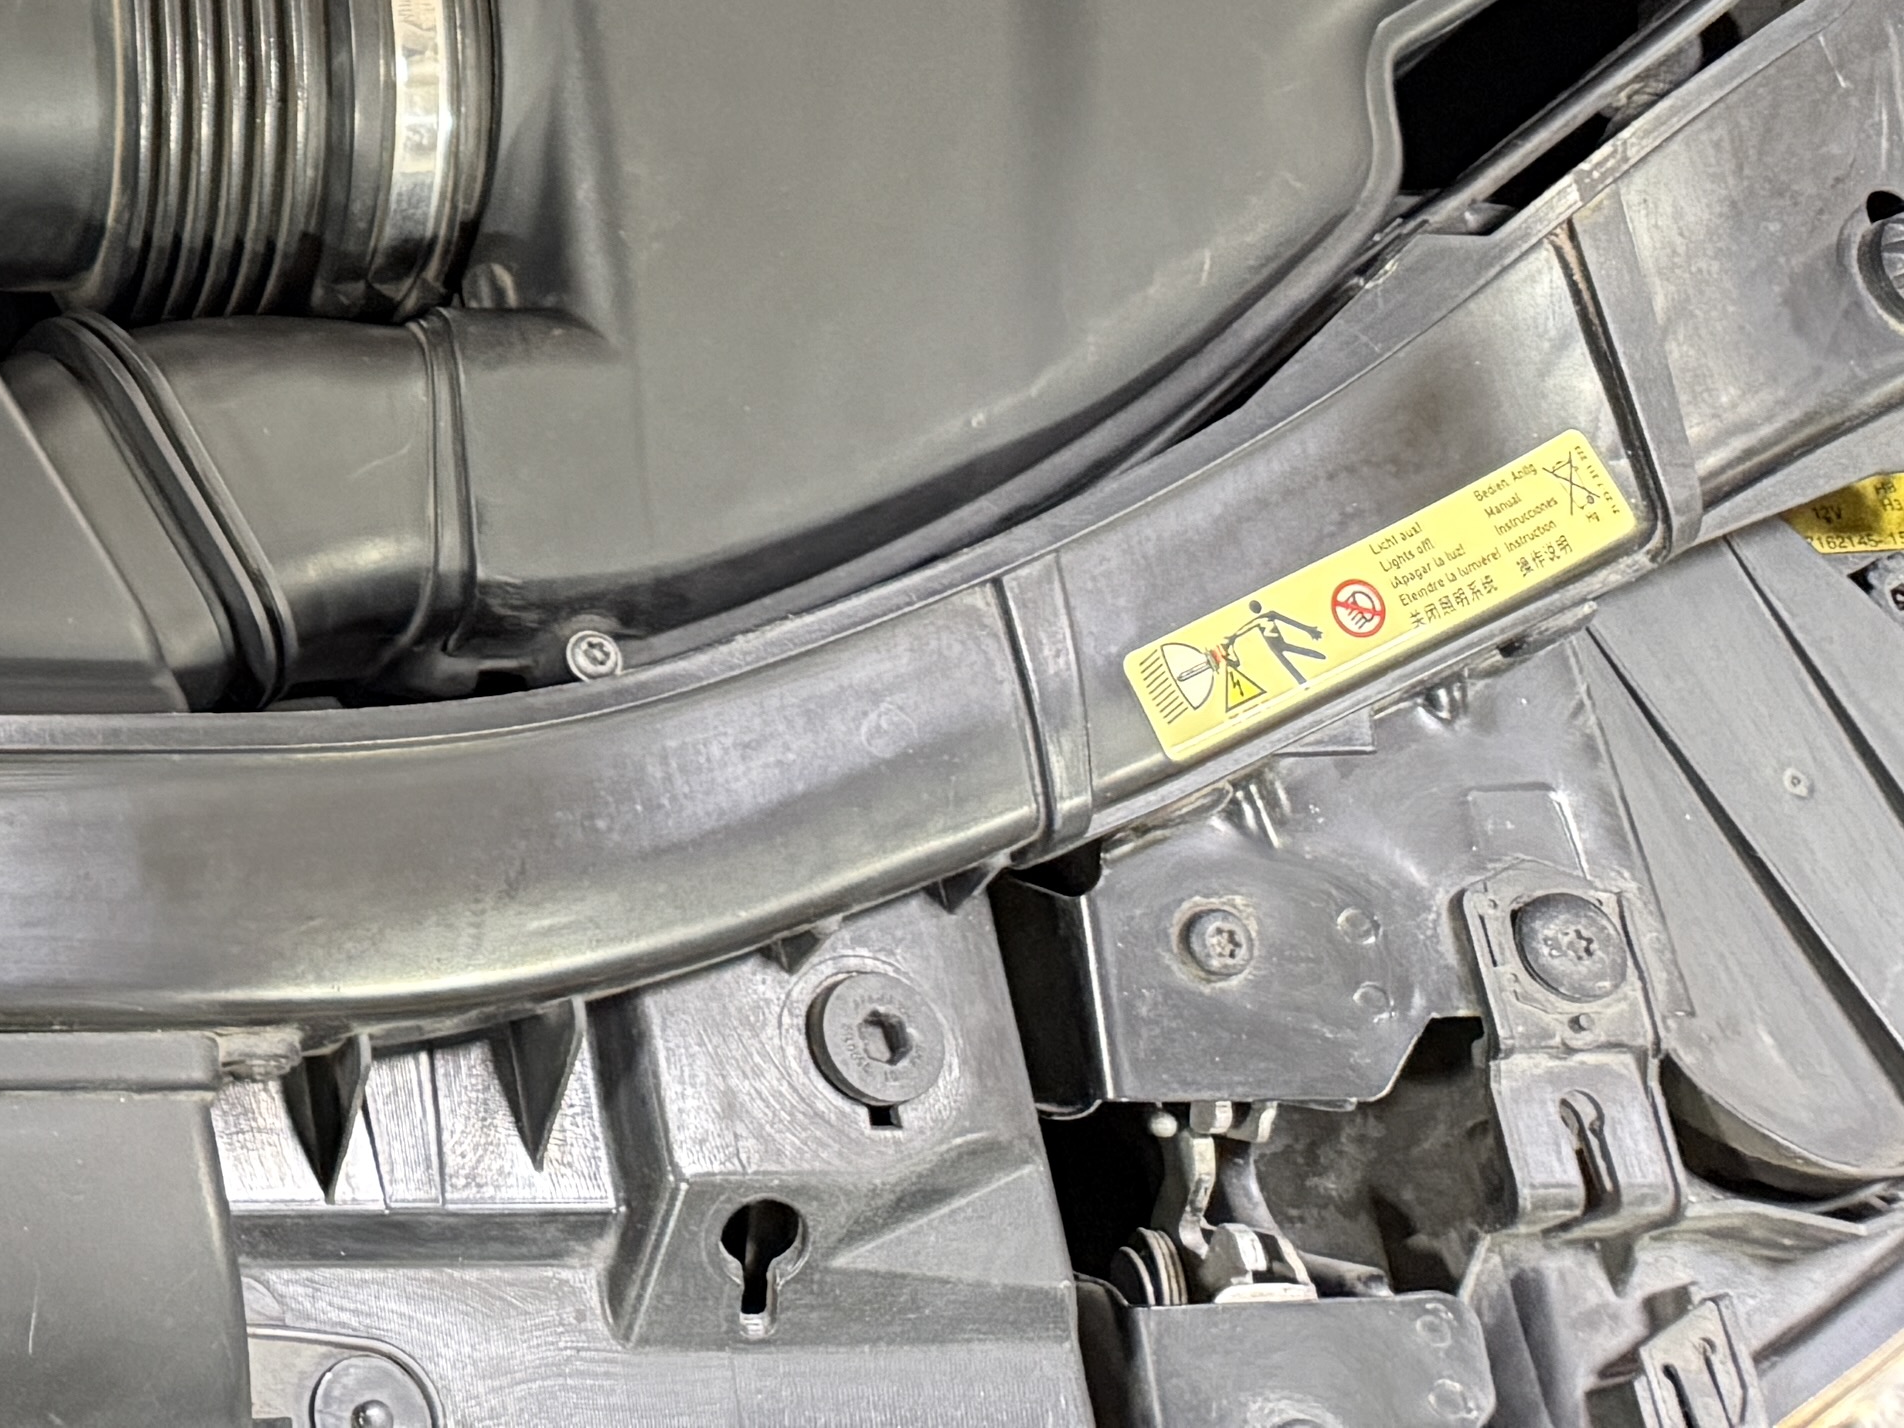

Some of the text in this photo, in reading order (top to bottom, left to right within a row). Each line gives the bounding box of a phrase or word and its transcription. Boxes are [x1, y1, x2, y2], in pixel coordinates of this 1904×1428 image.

[1483, 492, 1522, 518] Manual
[1368, 534, 1398, 555] Licht
[1503, 519, 1557, 552] Instruction
[1378, 549, 1415, 572] Lights
